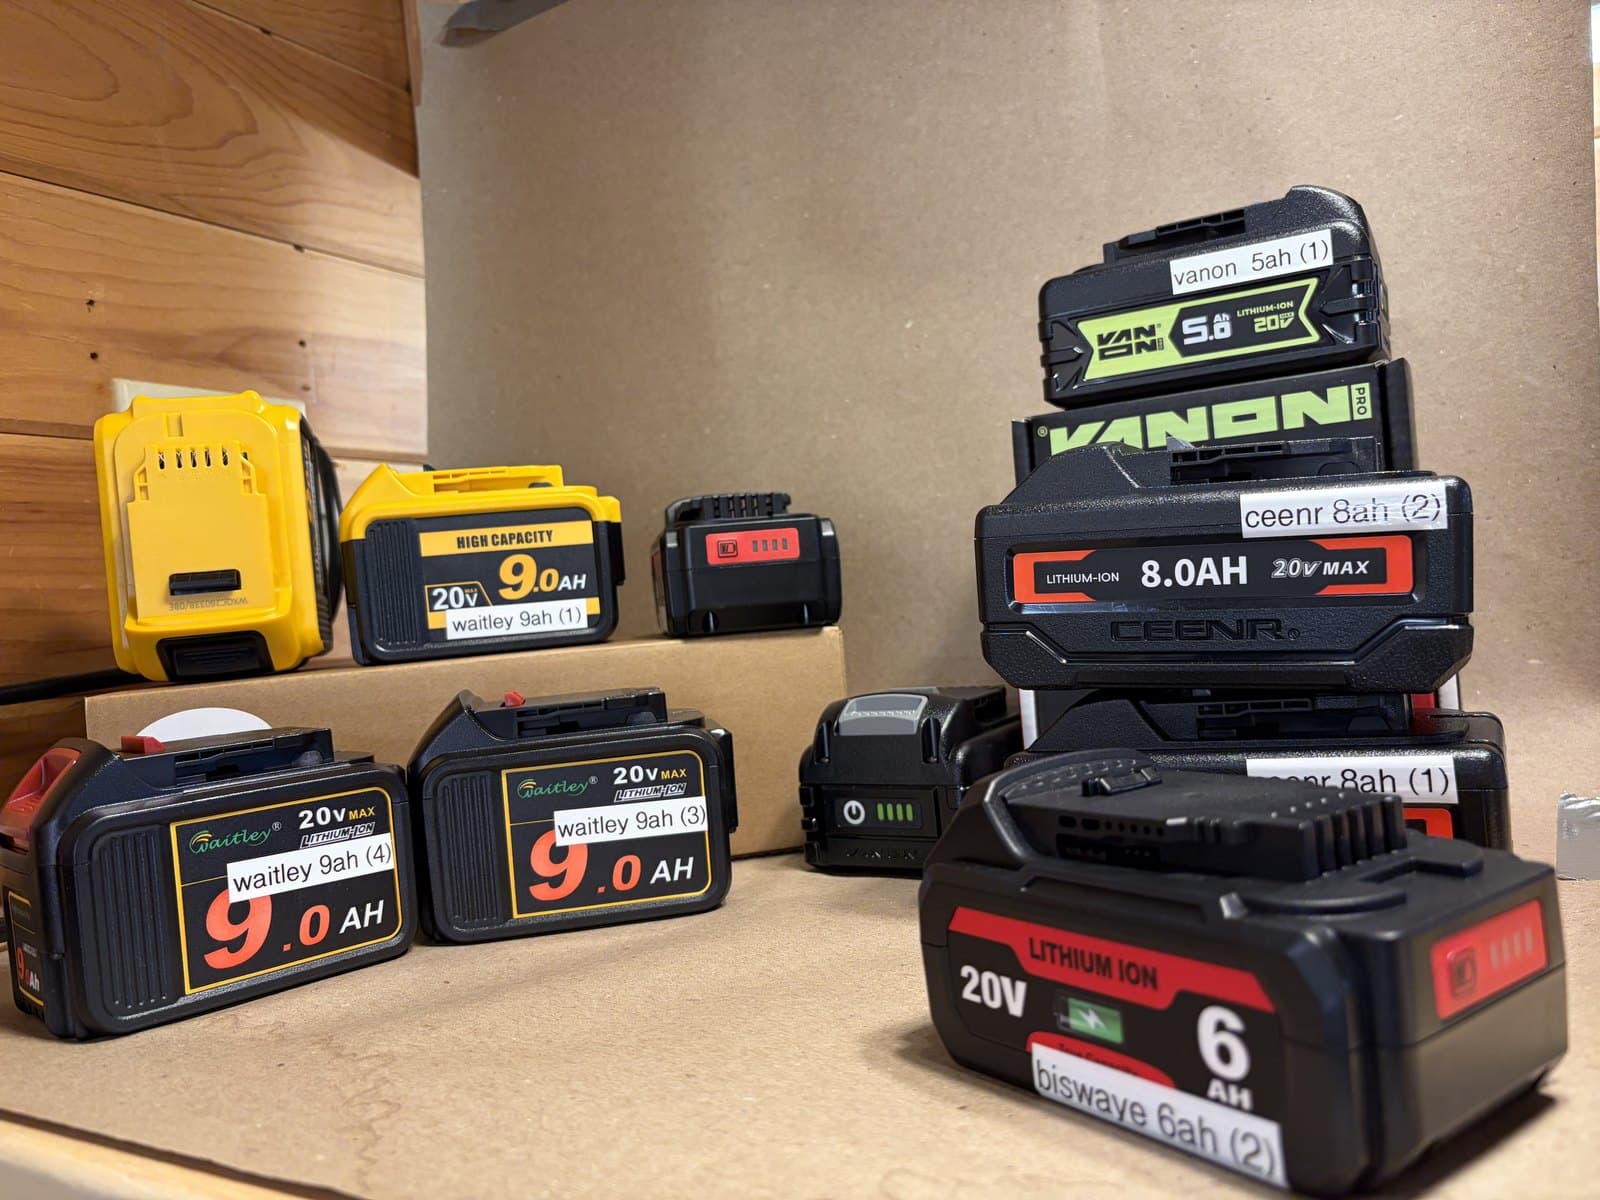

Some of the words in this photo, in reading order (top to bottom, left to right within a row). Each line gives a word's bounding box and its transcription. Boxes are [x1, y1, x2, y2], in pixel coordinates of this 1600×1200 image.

[1174, 260, 1237, 286] vanon
[1251, 248, 1292, 272] 5ah
[1300, 240, 1329, 262] (1)
[1236, 301, 1295, 318] LITHIUM-ION
[1181, 316, 1232, 345] 5.0
[1354, 386, 1369, 416] PRO
[1050, 385, 1352, 457] VANON
[1244, 504, 1324, 529] ceenr
[1332, 498, 1389, 524] 8ah
[1401, 494, 1441, 522] (2)
[456, 533, 489, 549] HIGH
[491, 529, 553, 546] CAPACITY
[1046, 571, 1120, 585] LITHIUM-ION
[1140, 555, 1248, 588] 8.0AH
[1322, 560, 1369, 576] MAX
[452, 612, 514, 633] waitley
[519, 609, 553, 628] 9ah
[559, 605, 582, 625] (1)
[1110, 618, 1285, 642] CEENR
[661, 768, 687, 780] MAX
[1340, 768, 1397, 793] 8ah
[1409, 767, 1449, 796] (1)
[614, 782, 687, 803] LITHIUM-ION
[348, 806, 376, 821] MAX
[557, 813, 629, 839] waitley
[635, 808, 674, 830] 9ah
[680, 805, 706, 827] (3)
[300, 822, 376, 849] LITHIUM-ION
[233, 861, 313, 892] waitley
[319, 851, 359, 876] 9ah
[366, 842, 392, 868] (4)
[649, 856, 694, 884] AH
[339, 900, 384, 934] AH
[1028, 936, 1113, 979] LITHIUM
[1119, 959, 1159, 990] ION
[960, 964, 1027, 1018] 20V
[1197, 1005, 1250, 1081] 6
[1207, 1078, 1253, 1111] AH
[1036, 1057, 1147, 1129] biswaye
[1157, 1102, 1219, 1154] 6ah
[1229, 1127, 1274, 1179] (2)
